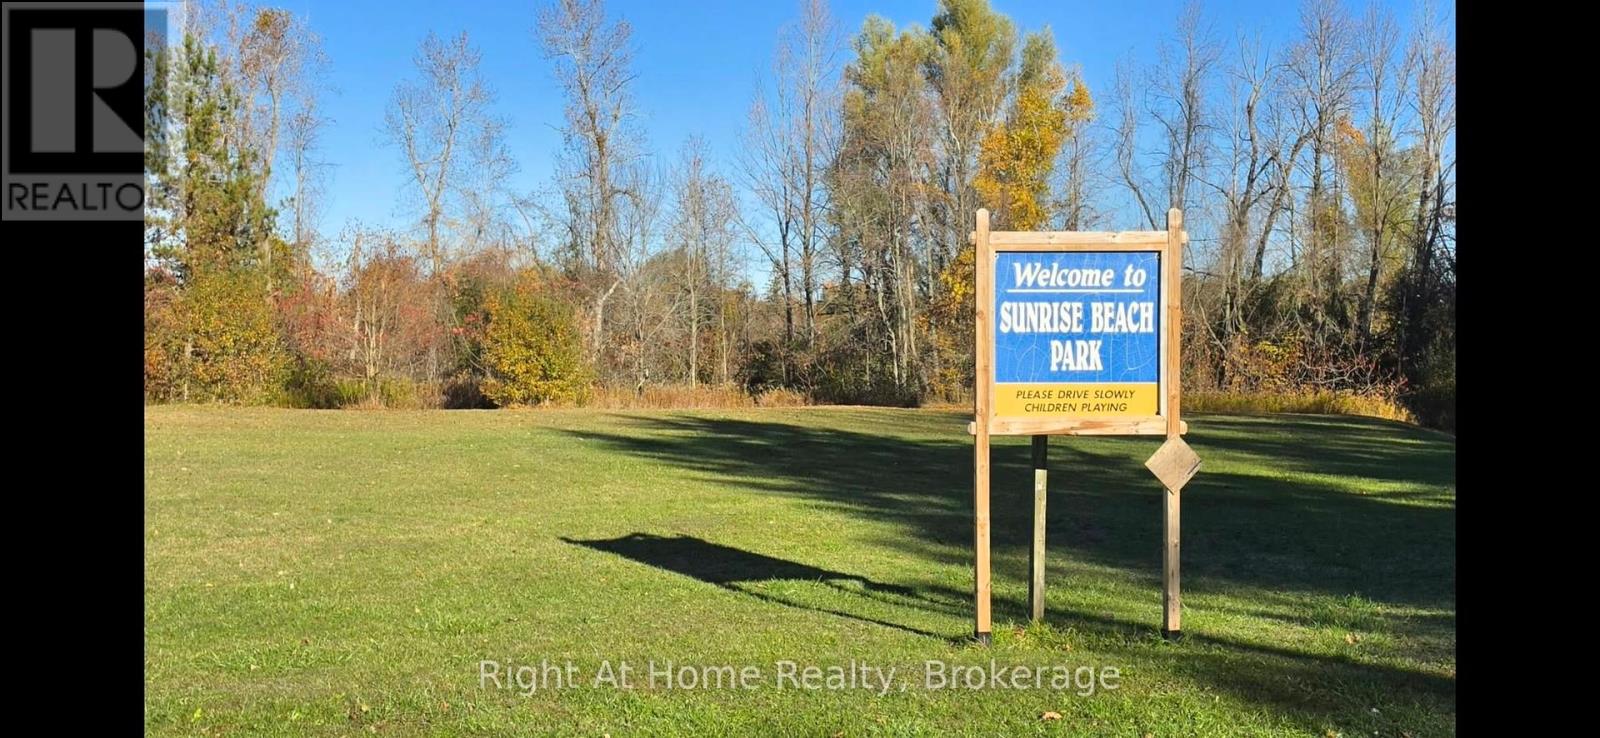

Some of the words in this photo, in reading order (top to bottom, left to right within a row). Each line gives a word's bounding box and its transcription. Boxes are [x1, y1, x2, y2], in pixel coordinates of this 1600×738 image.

[1013, 262, 1113, 287] Welcome
[1124, 264, 1147, 286] to
[999, 302, 1083, 333] SUNRISE
[1091, 302, 1154, 333] BEACH
[1050, 340, 1103, 371] PARK
[1016, 390, 1053, 400] PLEASE
[1057, 390, 1089, 399] DRIVE
[1094, 390, 1135, 399] SLOWLY
[1024, 403, 1077, 413] CHILDREN
[1081, 403, 1128, 412] PLAYING
